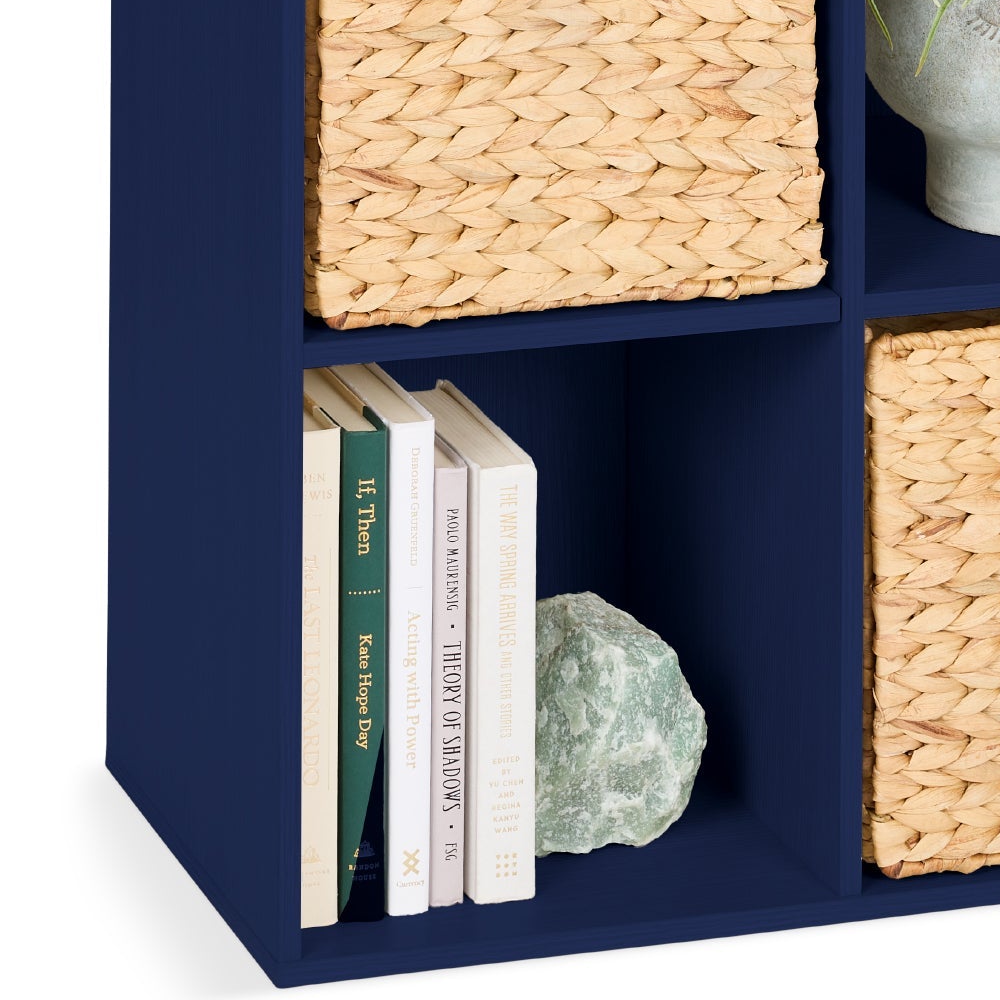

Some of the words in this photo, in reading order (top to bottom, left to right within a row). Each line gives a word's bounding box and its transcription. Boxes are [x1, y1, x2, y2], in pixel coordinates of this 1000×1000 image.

[355, 478, 376, 499] If,
[500, 484, 518, 507] THE
[357, 504, 376, 555] Then
[446, 508, 460, 543] PAOLO
[499, 513, 517, 539] WAY
[303, 556, 318, 580] The
[446, 548, 459, 611] MAURENSIG
[499, 544, 517, 589] SPRING
[303, 586, 320, 641] LAST
[498, 595, 517, 647] ARRIVES
[358, 634, 373, 669] Kate
[403, 611, 421, 667] Acting
[406, 671, 421, 710] with
[442, 641, 462, 704] THEORY
[500, 672, 512, 699] OTHER
[355, 673, 372, 715] Hope
[303, 648, 320, 786] LEONARDO
[355, 718, 372, 750] Day
[442, 711, 461, 730] OF
[500, 703, 512, 739] STORIES
[406, 714, 420, 768] Power
[442, 735, 461, 812] SHADOWS
[492, 755, 520, 765] EDITED
[498, 791, 515, 799] AND
[445, 843, 457, 861] FSG
